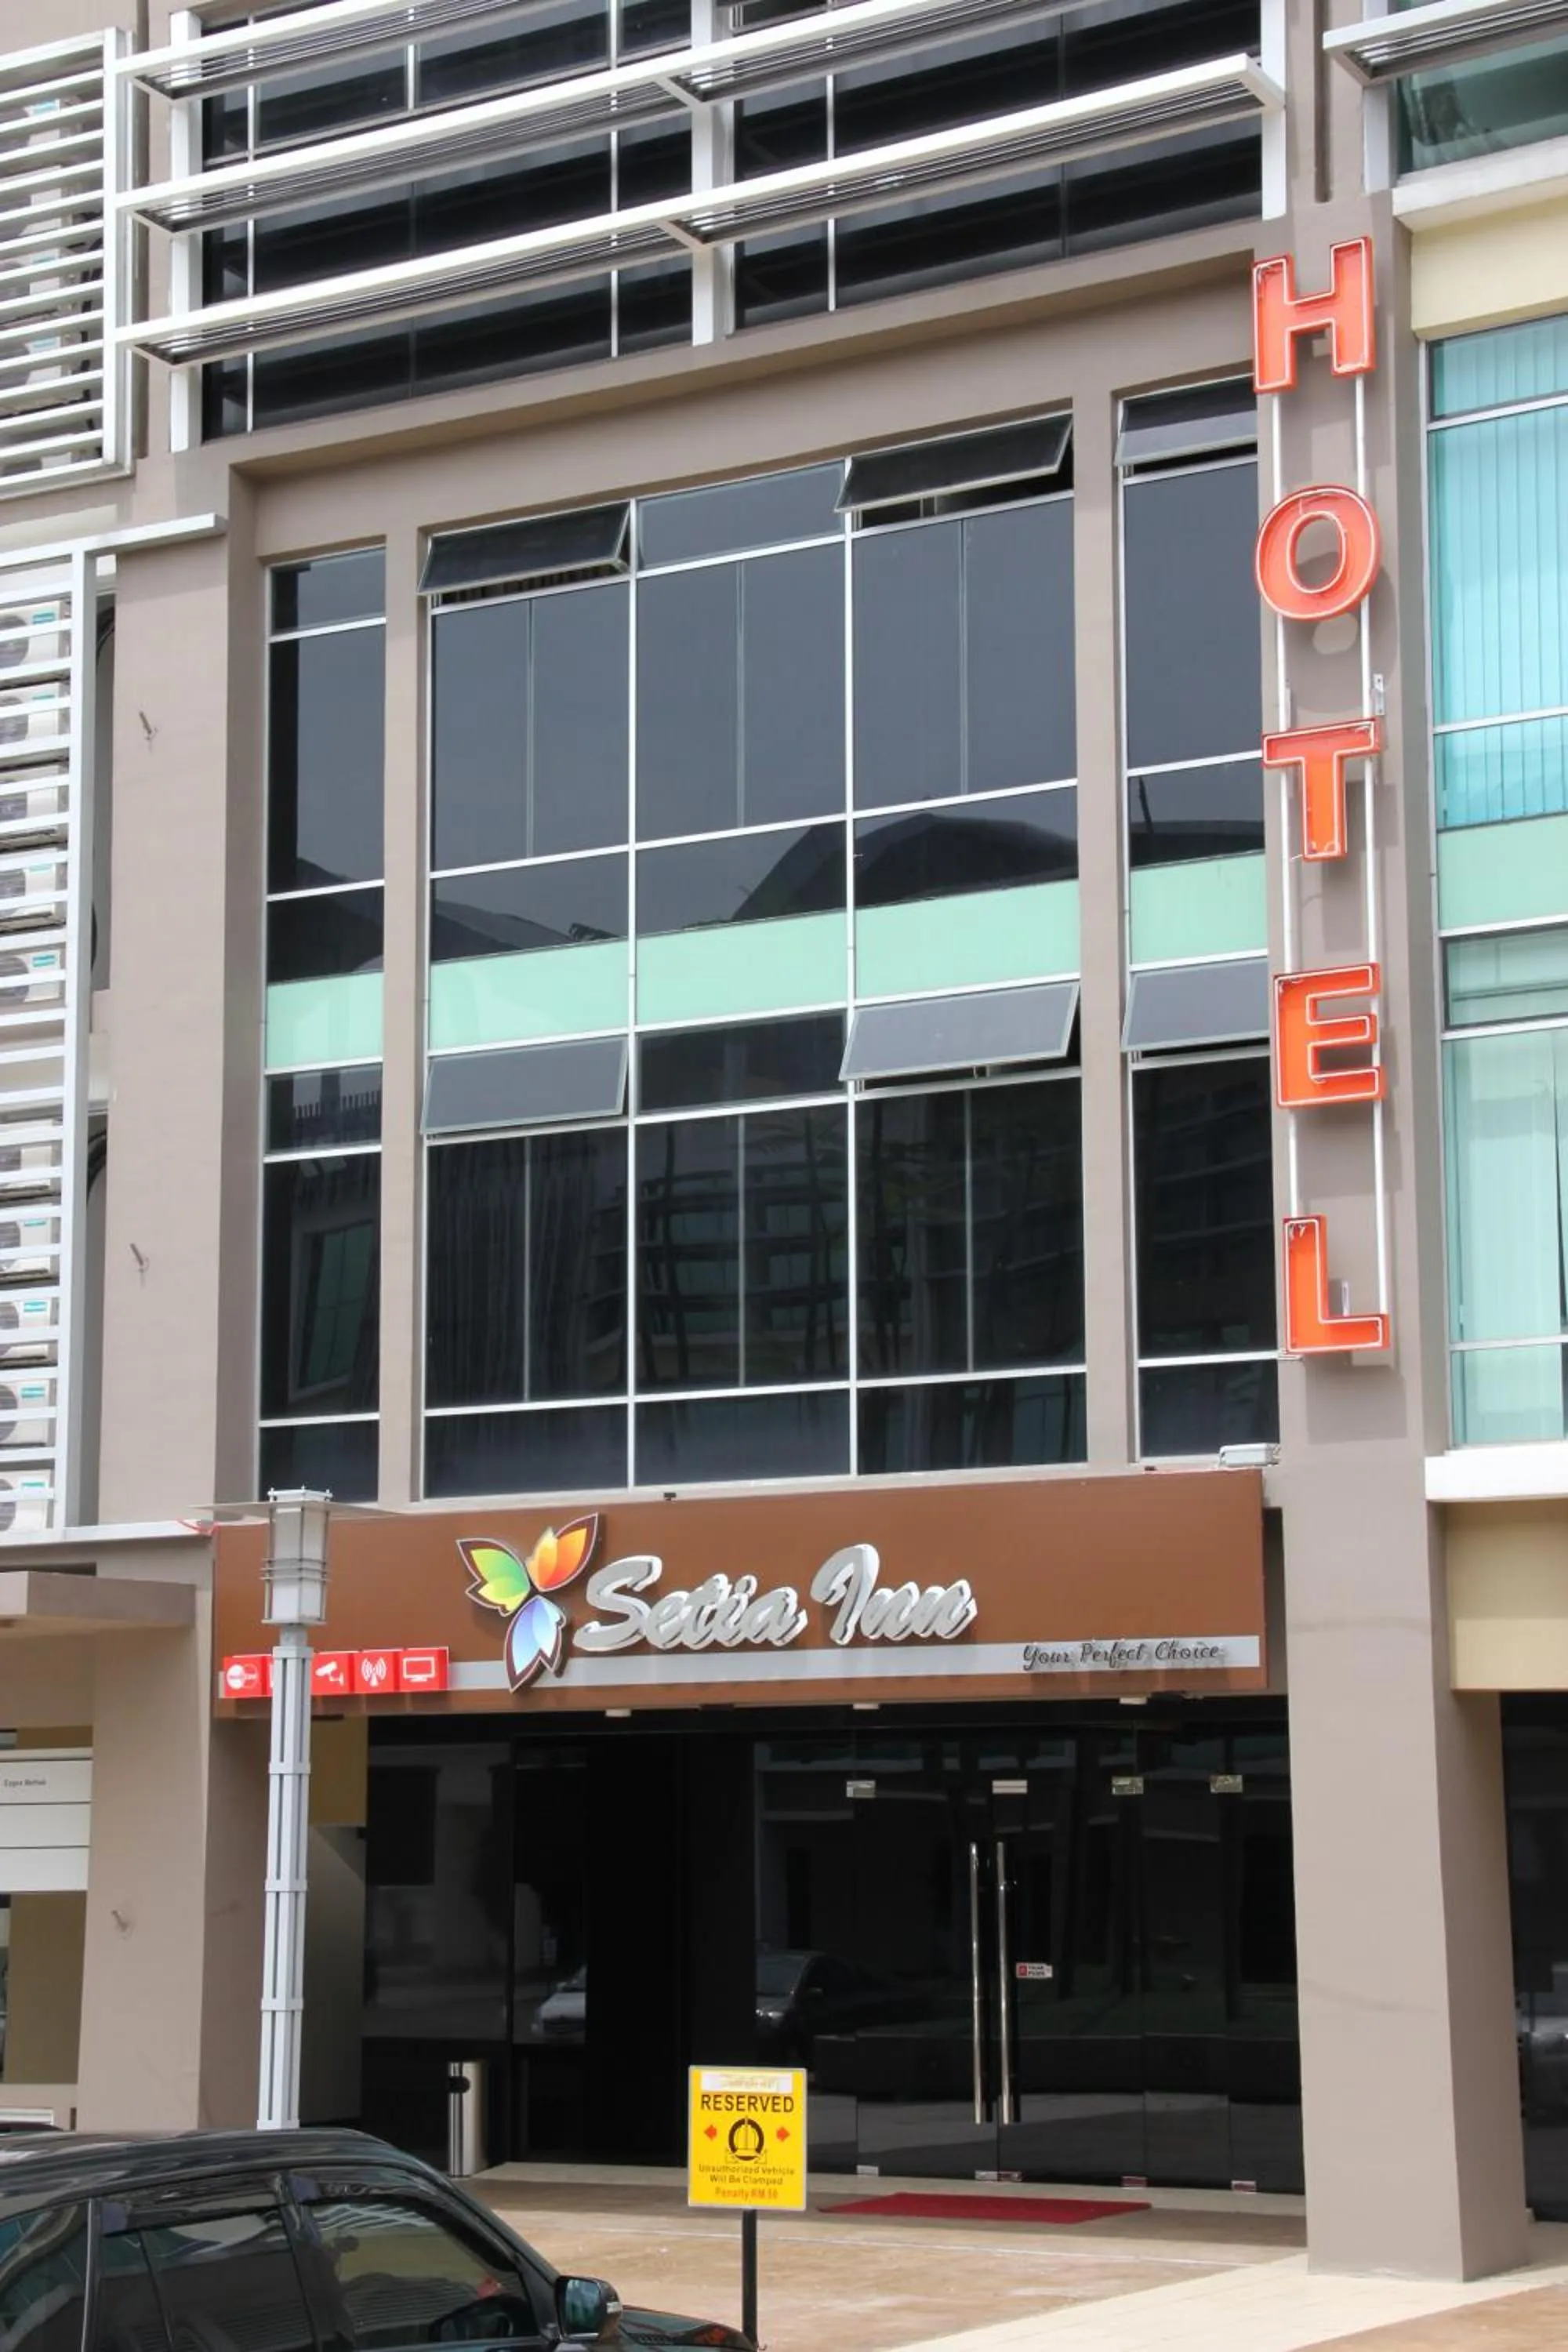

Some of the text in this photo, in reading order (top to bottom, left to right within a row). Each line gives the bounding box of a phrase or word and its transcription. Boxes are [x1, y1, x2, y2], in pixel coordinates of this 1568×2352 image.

[1252, 236, 1387, 1355] HOTEL
[572, 1544, 978, 1652] Setia Inn
[1022, 1639, 1219, 1671] Your Perfect Choice
[701, 2094, 794, 2113] RESERVED
[699, 2163, 760, 2174] Unauthorized
[710, 2174, 783, 2186] Will Be Clamped
[715, 2187, 749, 2201] Penalty
